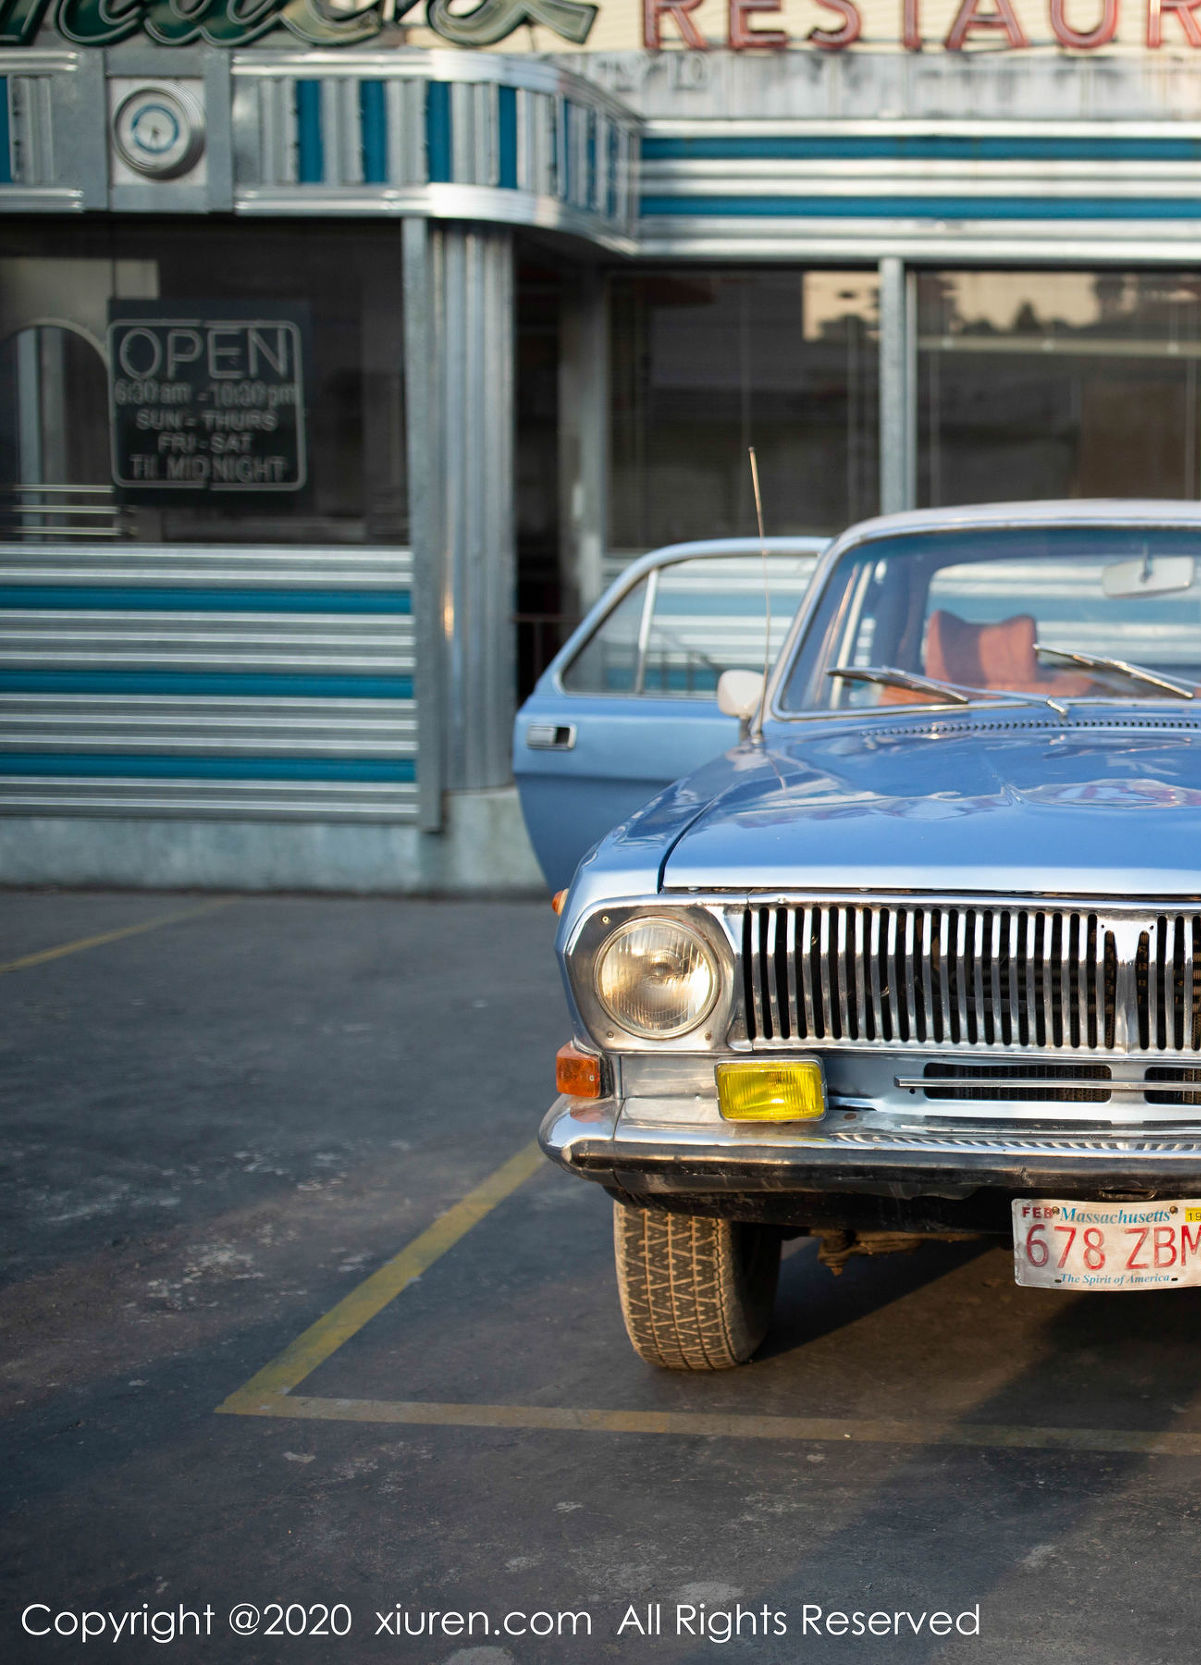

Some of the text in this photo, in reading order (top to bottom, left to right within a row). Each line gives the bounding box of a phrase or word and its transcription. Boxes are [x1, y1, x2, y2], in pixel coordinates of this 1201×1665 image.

[119, 327, 288, 380] OPEN
[135, 408, 184, 431] SUN
[200, 409, 279, 432] THURS
[158, 431, 196, 454] FRI
[210, 432, 254, 454] SAT
[1022, 1206, 1053, 1219] FEB
[1060, 1207, 1171, 1225] Massachusetts
[1026, 1223, 1106, 1270] 678
[1060, 1273, 1171, 1286] The Spirit of America
